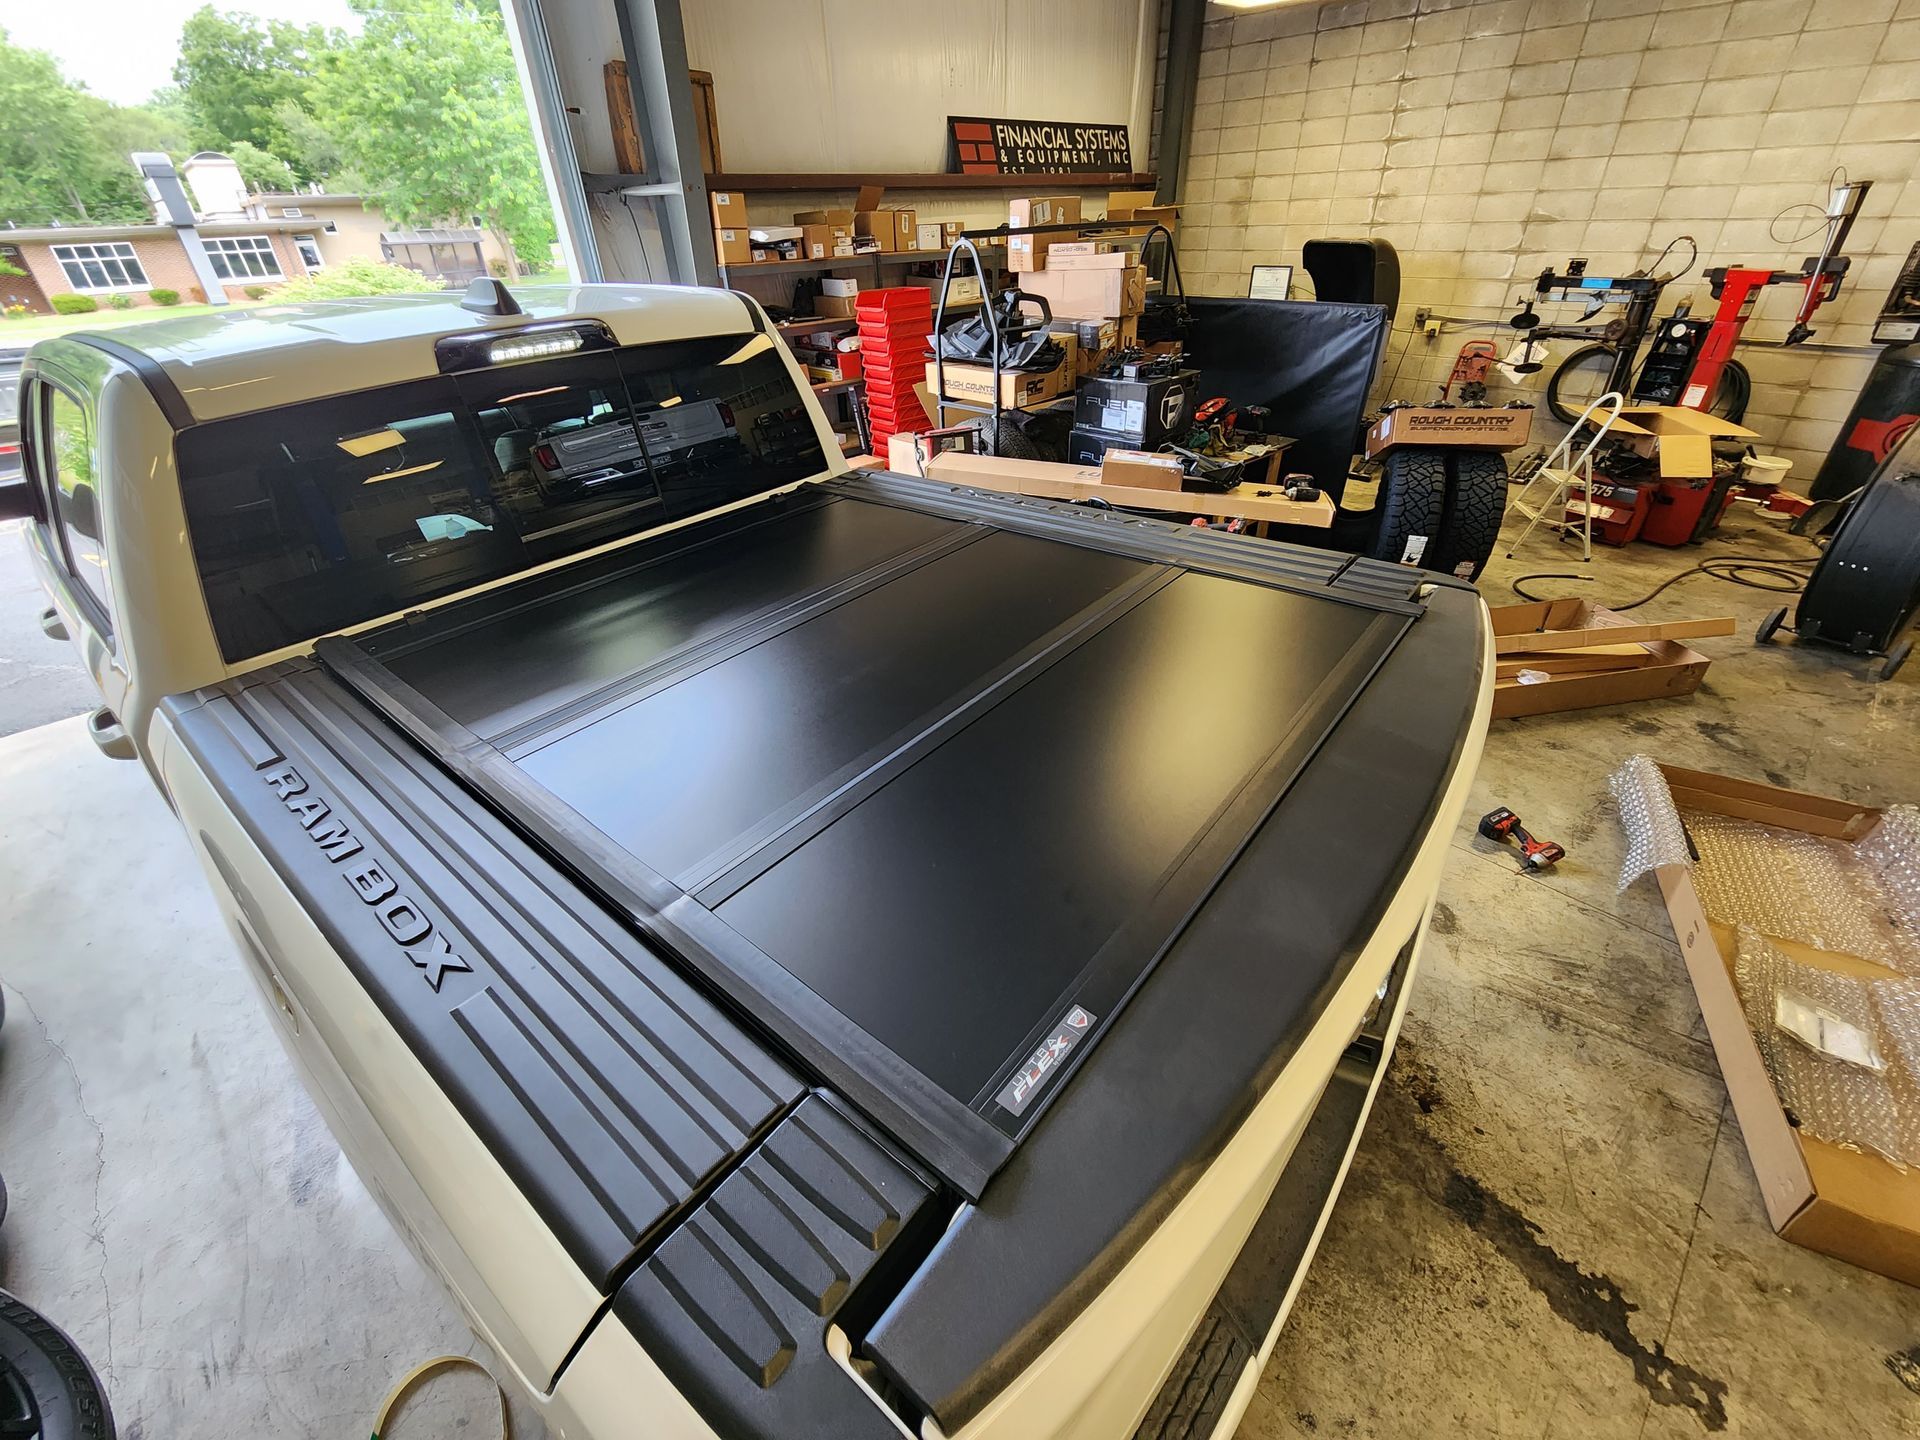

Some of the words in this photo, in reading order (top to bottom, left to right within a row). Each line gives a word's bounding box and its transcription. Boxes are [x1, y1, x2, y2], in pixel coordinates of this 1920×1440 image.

[996, 124, 1073, 149] FINANCIAL
[1074, 128, 1127, 151] SYSTEMS
[1000, 149, 1008, 163] &
[1017, 149, 1101, 166] EQUIPMENT,
[1108, 151, 1129, 164] INC
[944, 379, 964, 389] OUGH
[965, 382, 995, 393] COUNTR
[1086, 396, 1128, 413] FUEL
[1409, 416, 1452, 425] ROUGH
[1453, 416, 1515, 426] COUNTRY
[1080, 451, 1105, 464] FU
[264, 766, 364, 863] RAM
[343, 858, 474, 993] BOX
[1012, 1038, 1057, 1087] ULTRA
[1013, 1034, 1070, 1104] FLEX
